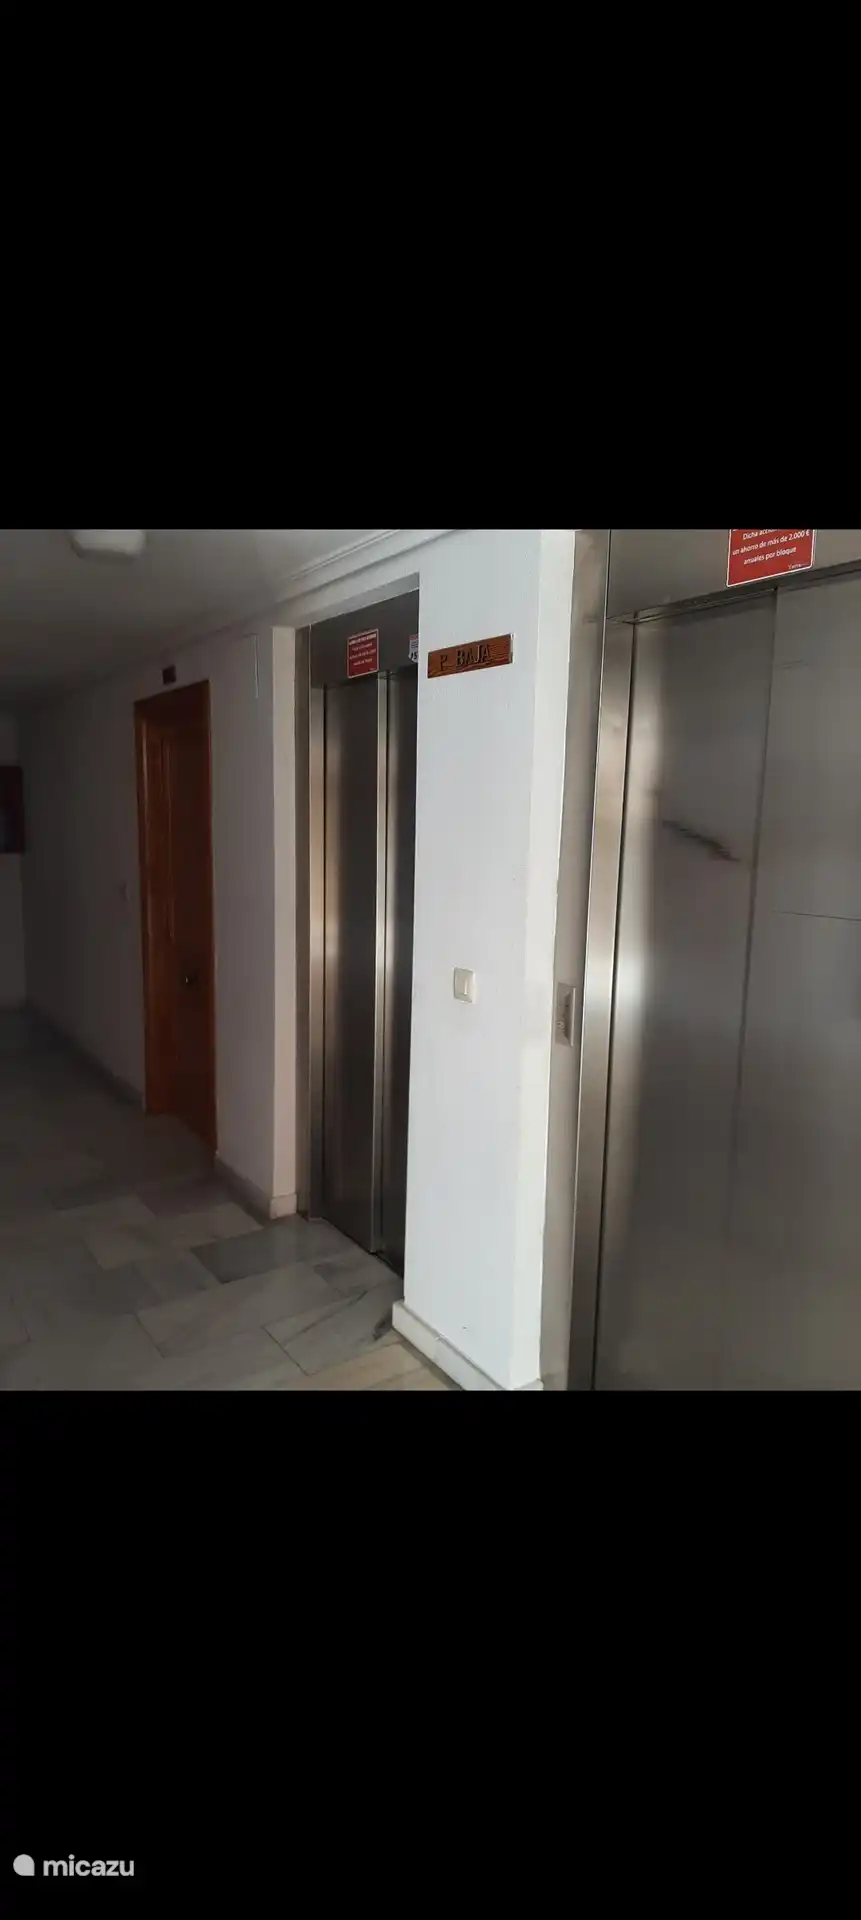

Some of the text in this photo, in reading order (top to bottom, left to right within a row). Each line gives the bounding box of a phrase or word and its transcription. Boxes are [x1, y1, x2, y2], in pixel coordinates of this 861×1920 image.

[740, 543, 759, 554] ahorro
[759, 540, 767, 548] de
[767, 537, 780, 546] más
[788, 530, 805, 541] 2.000
[805, 529, 810, 537] €
[742, 531, 758, 541] Dicha
[744, 546, 797, 565] anuales por bloque
[456, 644, 490, 667] BAJA
